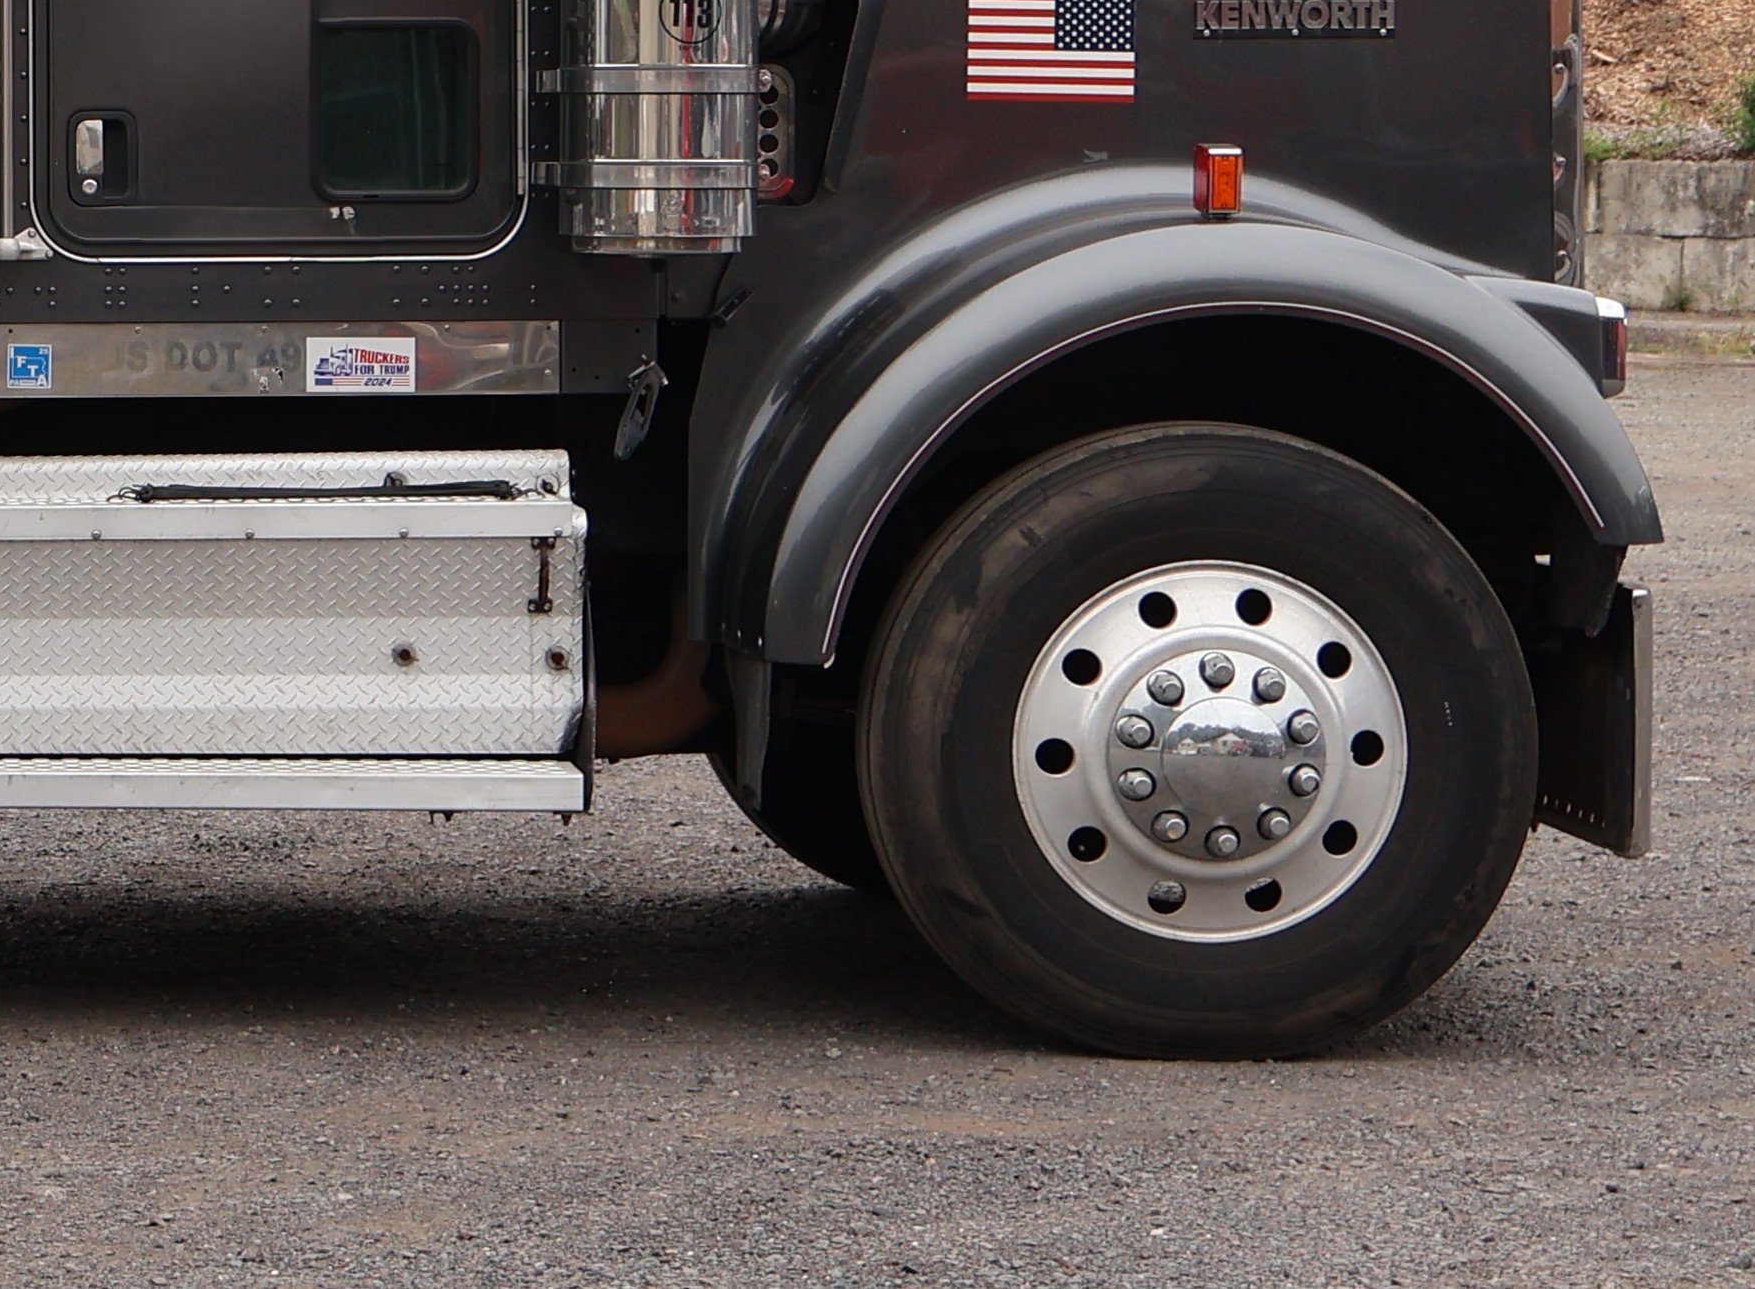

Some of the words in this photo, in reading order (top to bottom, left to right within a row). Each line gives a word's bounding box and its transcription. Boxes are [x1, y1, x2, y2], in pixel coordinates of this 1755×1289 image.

[163, 341, 243, 373] DOT
[354, 347, 410, 364] TRUCKERS
[354, 364, 375, 375] FOR
[379, 364, 410, 375] TRUMP
[363, 377, 393, 387] 2024
